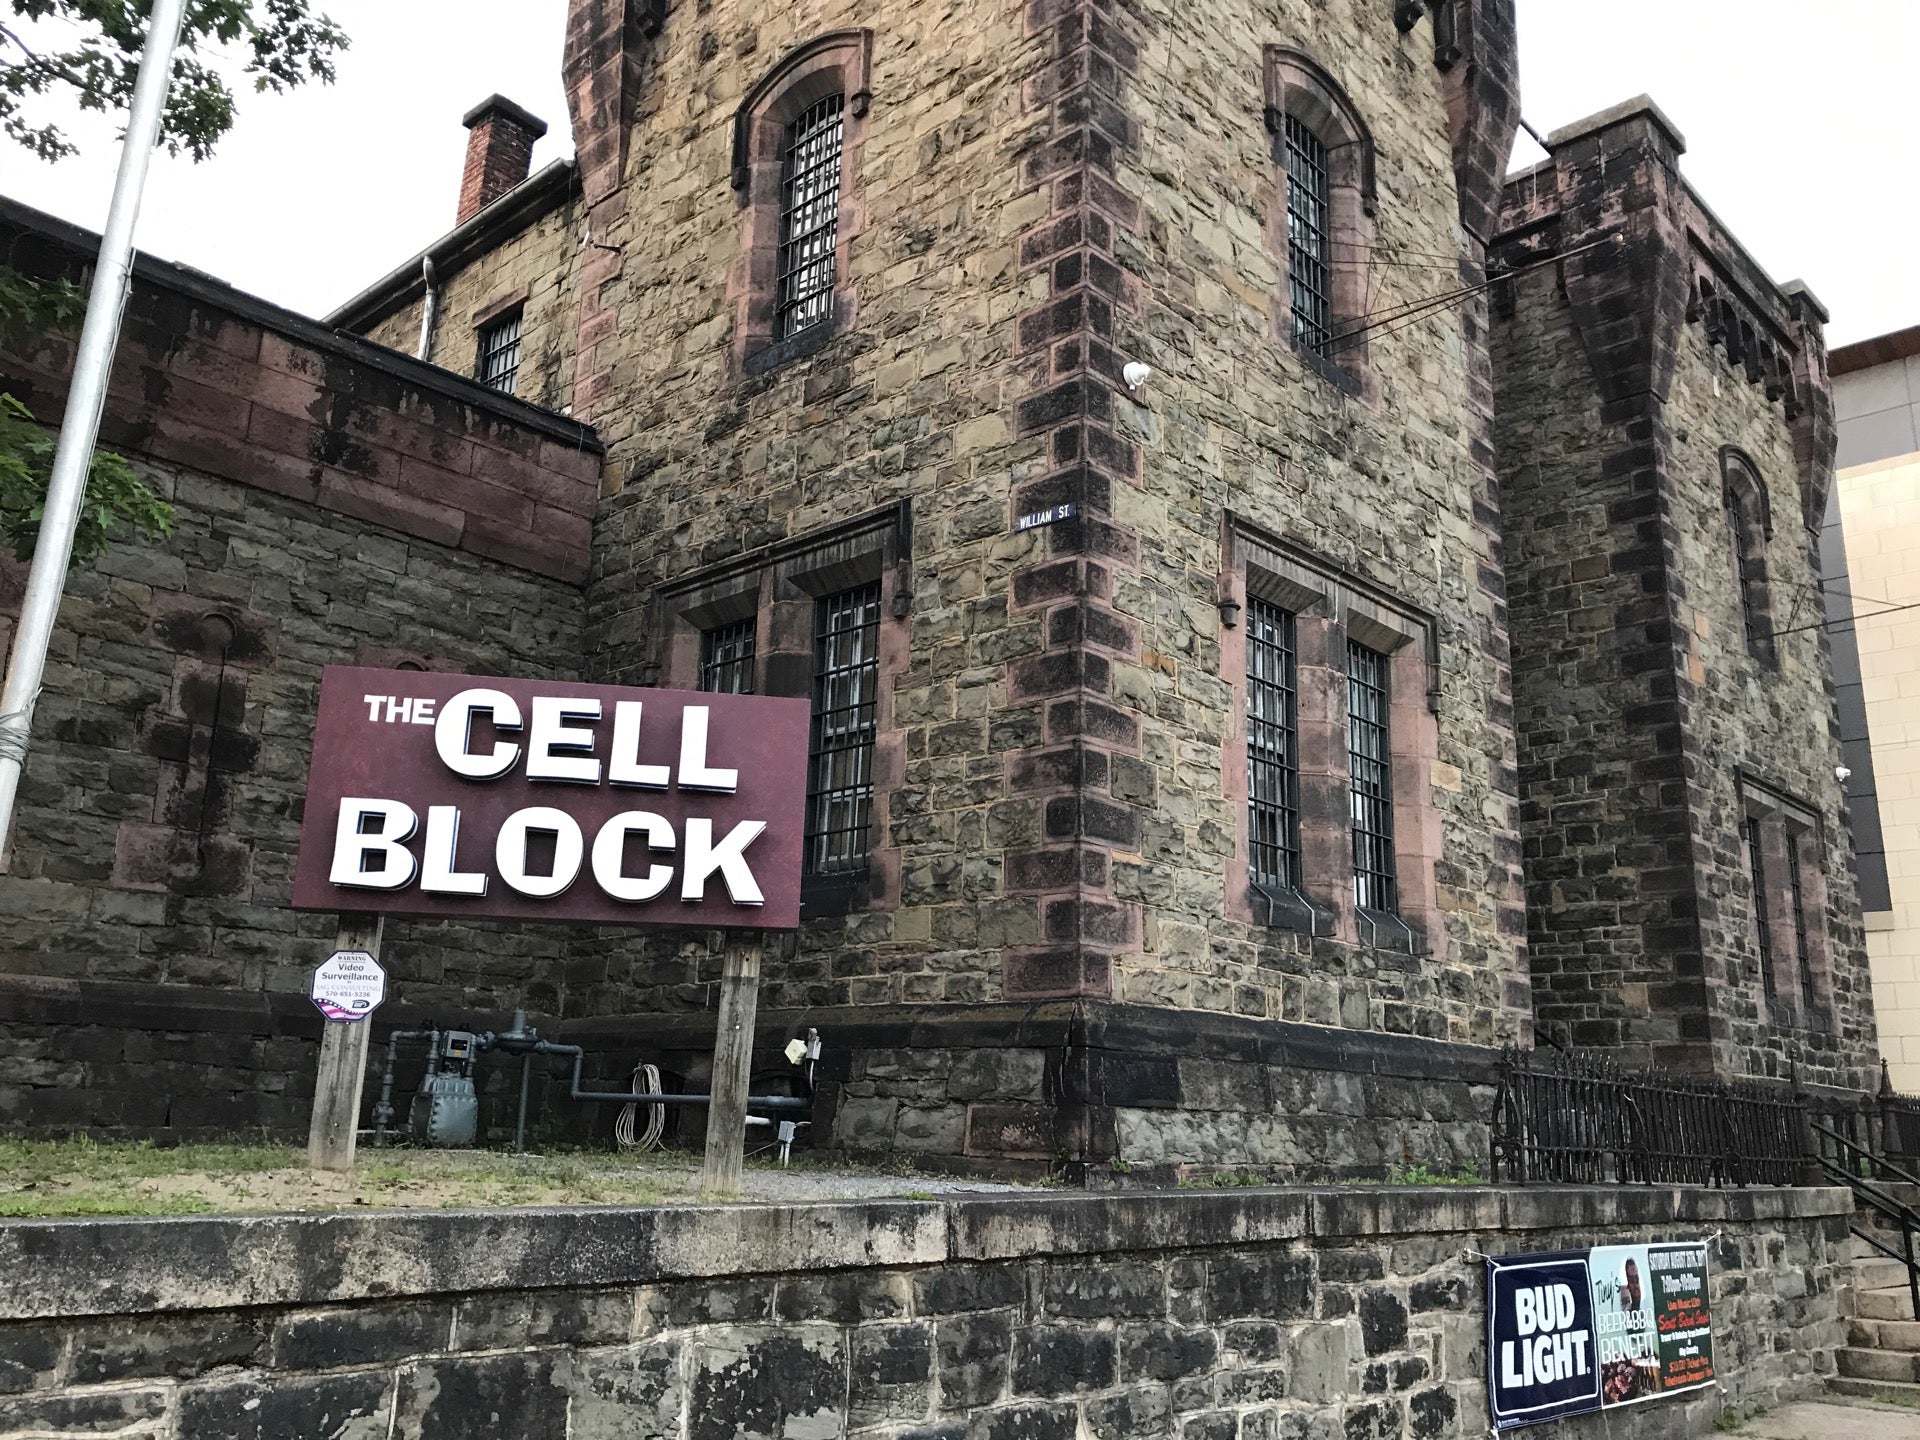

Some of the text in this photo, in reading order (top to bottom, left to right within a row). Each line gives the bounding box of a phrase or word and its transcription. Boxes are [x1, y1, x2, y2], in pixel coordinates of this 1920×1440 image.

[1020, 504, 1070, 529] WILLIAM ST.
[364, 688, 739, 793] THE CELL
[329, 797, 768, 907] BLOCK
[321, 972, 378, 981] Surveillance
[338, 963, 364, 971] Video
[1515, 1283, 1576, 1336] BUD
[1502, 1330, 1590, 1389] LIGHT
[1601, 1331, 1656, 1365] BENEFIT
